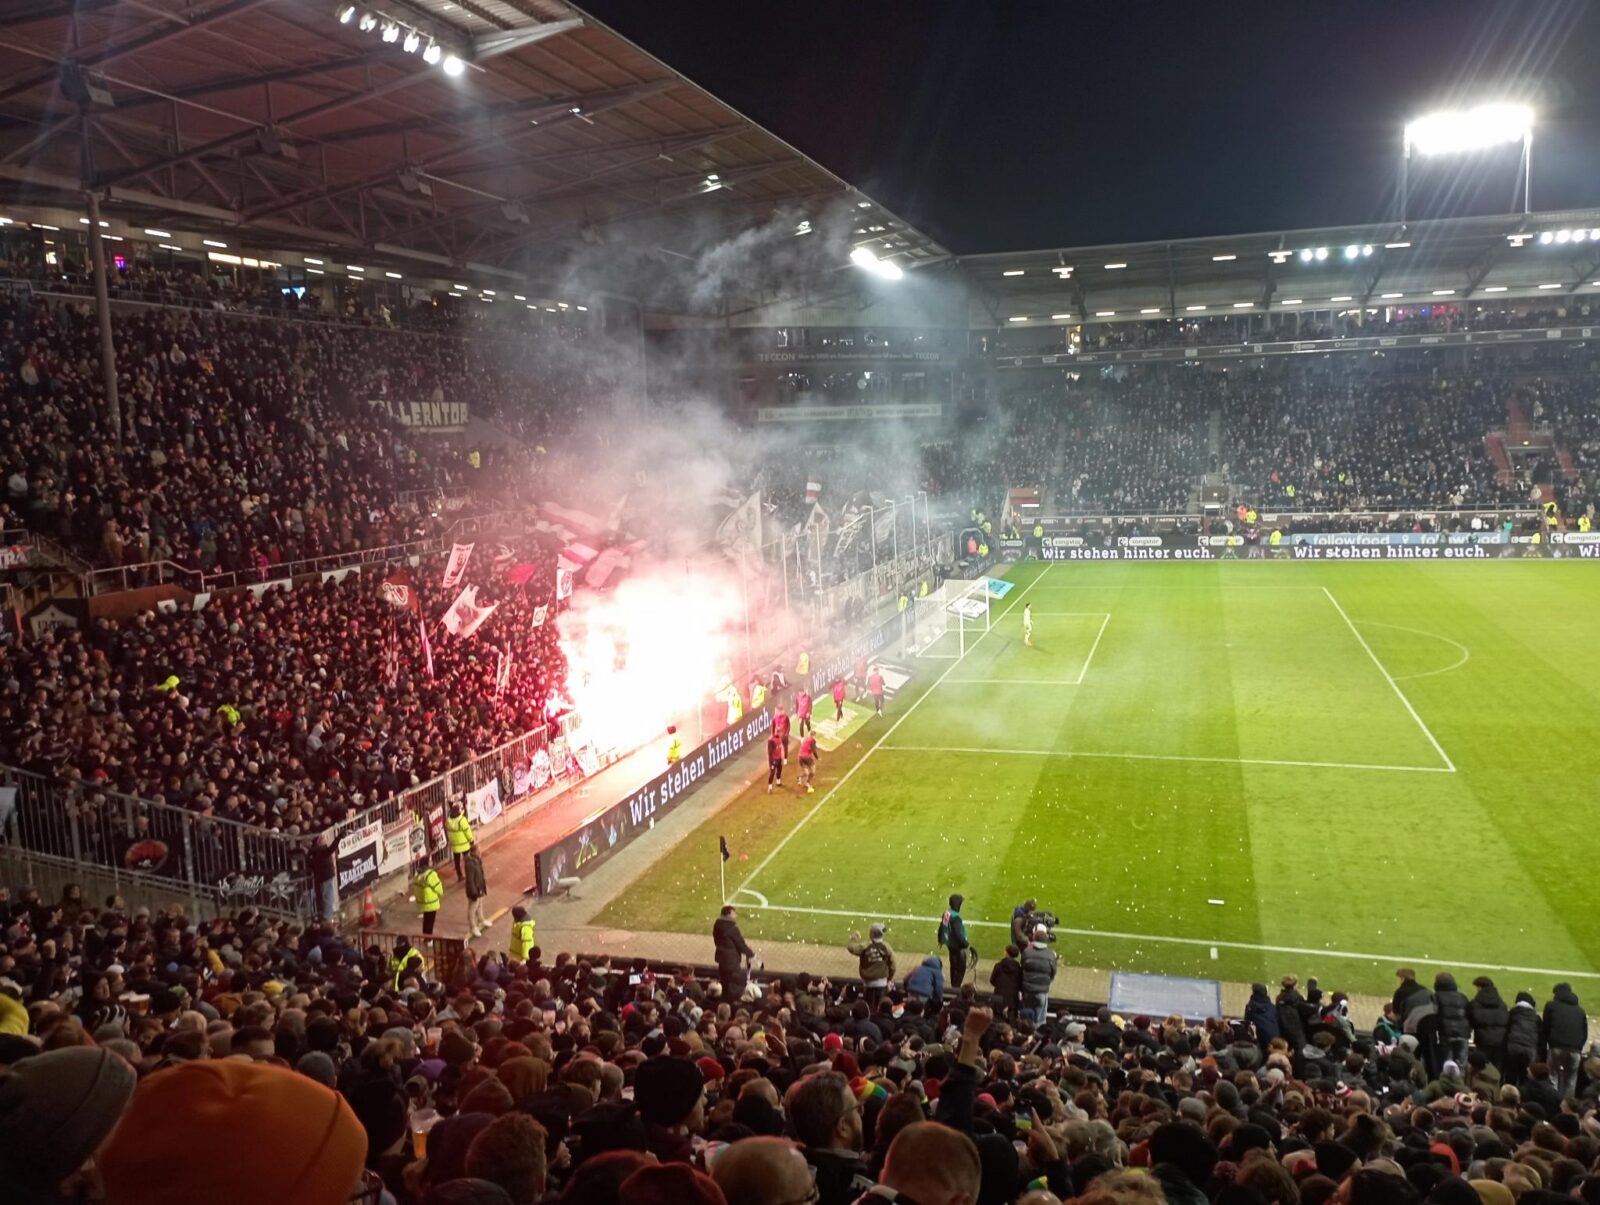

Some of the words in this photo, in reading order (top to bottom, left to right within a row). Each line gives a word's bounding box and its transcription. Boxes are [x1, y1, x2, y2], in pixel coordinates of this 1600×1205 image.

[1313, 533, 1390, 545] followfood
[1041, 547, 1066, 559] Wir
[1070, 547, 1119, 559] stehen
[1123, 547, 1170, 559] hinter
[1174, 547, 1216, 559] euch.
[1293, 545, 1321, 559] Wir
[1325, 545, 1382, 558] stehen
[1386, 545, 1440, 558] hinter
[1444, 545, 1490, 558] euch.
[629, 786, 656, 827] Wir
[660, 754, 705, 806] stehen
[708, 728, 744, 769] hinter
[746, 706, 773, 741] euch.
